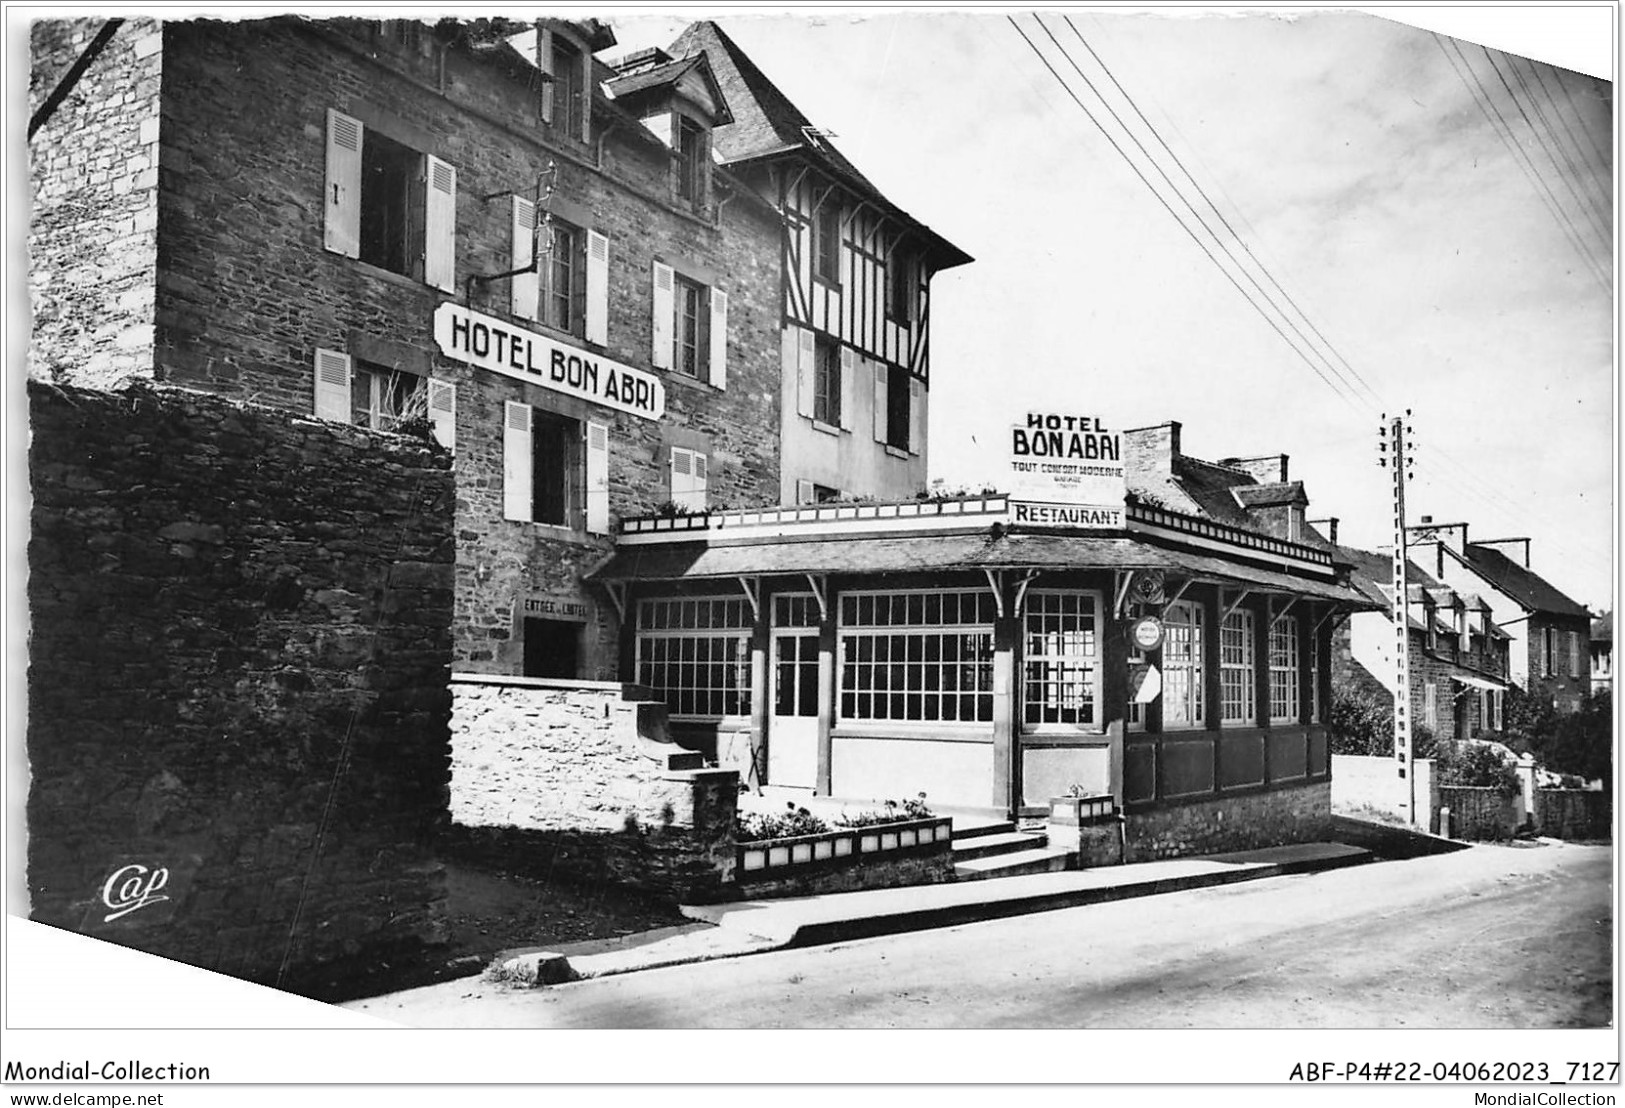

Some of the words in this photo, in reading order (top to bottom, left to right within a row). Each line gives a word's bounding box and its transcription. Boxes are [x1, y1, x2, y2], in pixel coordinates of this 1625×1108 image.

[452, 314, 542, 376] HOTEL
[550, 348, 598, 394] BON
[604, 368, 656, 412] ABRI
[1027, 413, 1108, 433] HOTEL
[1013, 429, 1064, 458] BON
[1011, 461, 1038, 472] TOUT
[1041, 463, 1078, 474] CONFORT
[1079, 465, 1124, 477] MODERNE
[1015, 504, 1120, 525] RESTAURANT
